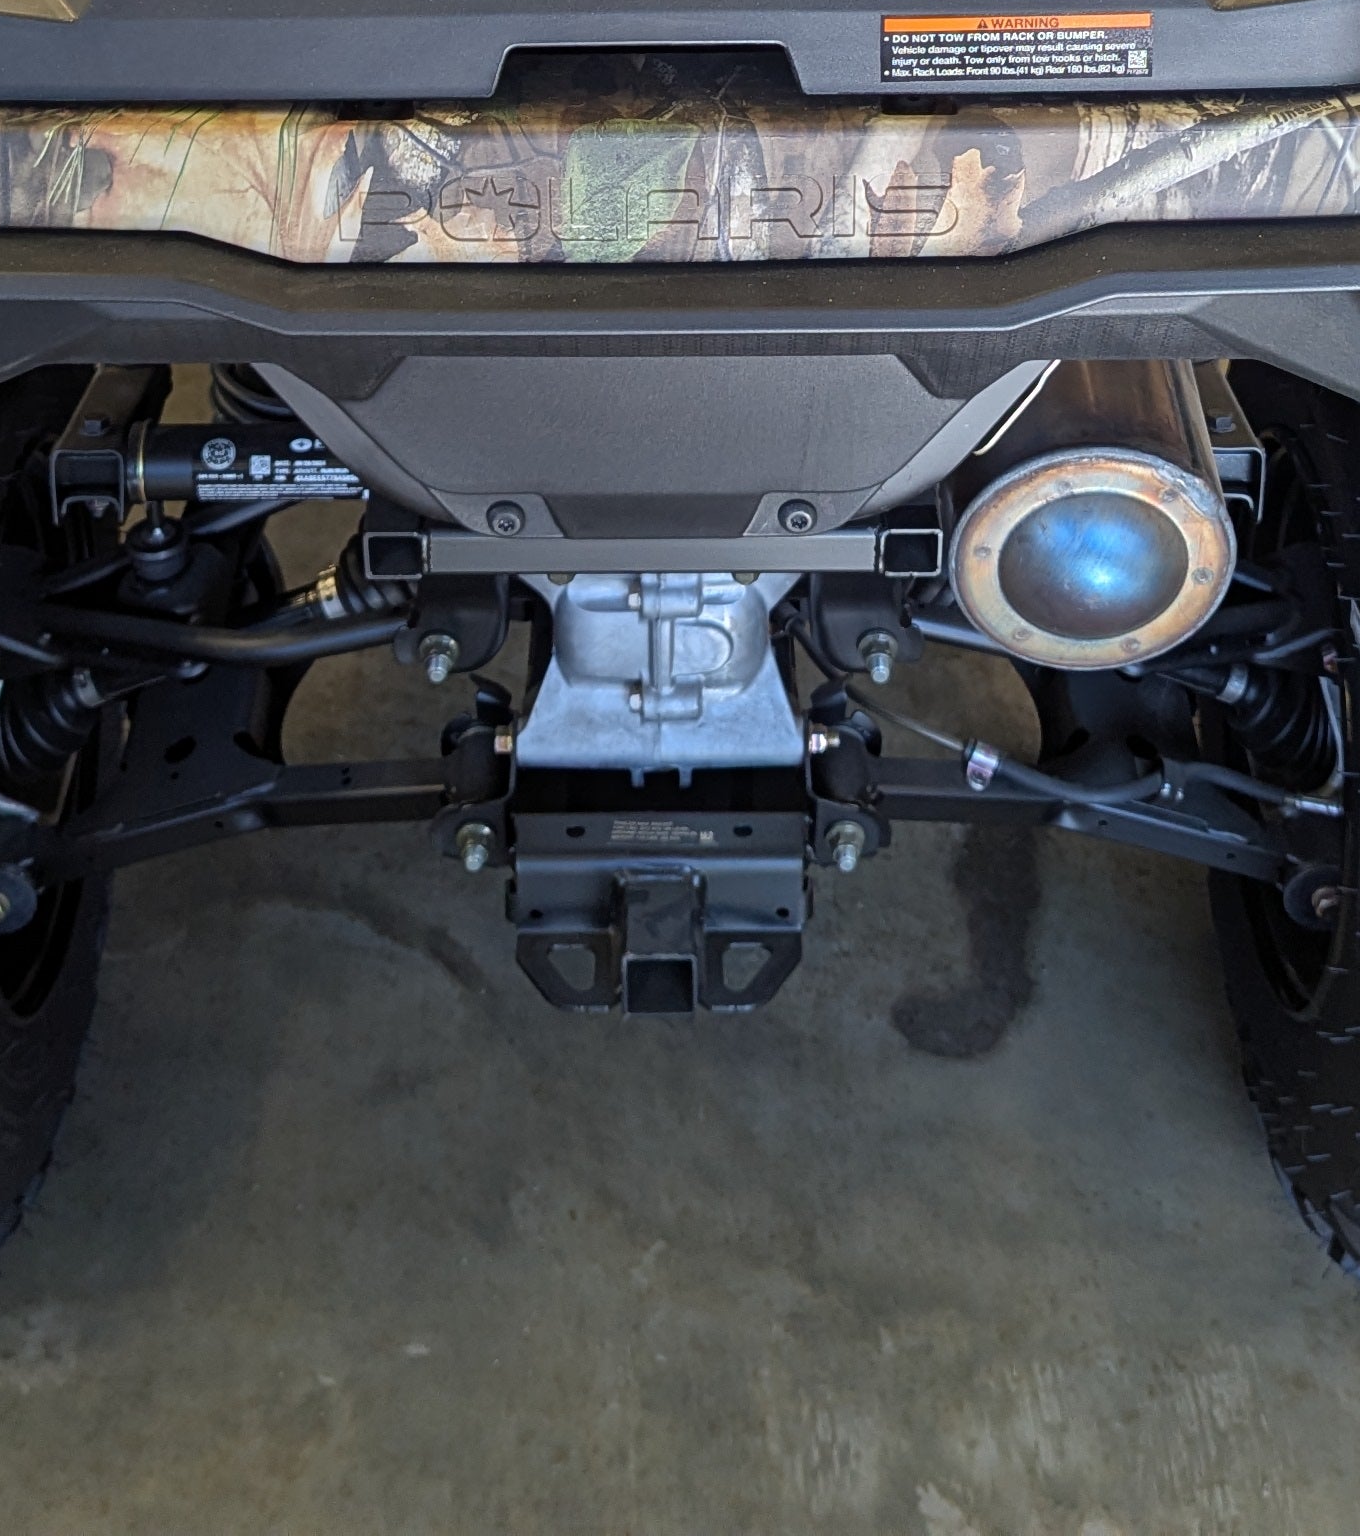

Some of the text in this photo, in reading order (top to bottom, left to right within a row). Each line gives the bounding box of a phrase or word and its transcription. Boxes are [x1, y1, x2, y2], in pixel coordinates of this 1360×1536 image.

[991, 17, 1060, 30] WARNING
[892, 31, 1108, 43] DO NOT TOW FROM RACK OR BUMPER.
[891, 45, 926, 55] Vehicle
[928, 45, 967, 55] damage
[980, 44, 1014, 55] tipover
[1015, 45, 1035, 54] may
[1037, 43, 1064, 52] result
[1065, 43, 1104, 53] causing
[1105, 42, 1136, 51] severe
[891, 57, 918, 67] injury
[932, 56, 962, 65] death.
[964, 55, 984, 64] Tow
[986, 55, 1007, 65] only
[1008, 54, 1031, 64] from
[1032, 54, 1050, 63] tow
[1052, 54, 1082, 63] hooks
[1095, 53, 1121, 62] hitch.
[891, 68, 912, 77] Max.
[913, 68, 935, 77] Rack
[936, 67, 965, 76] Loads:
[966, 66, 989, 75] Front
[990, 67, 1002, 75] 90
[1030, 66, 1045, 76] kg)
[1045, 65, 1065, 74] Rear
[1112, 64, 1126, 74] kg)
[338, 172, 959, 242] POLARIS
